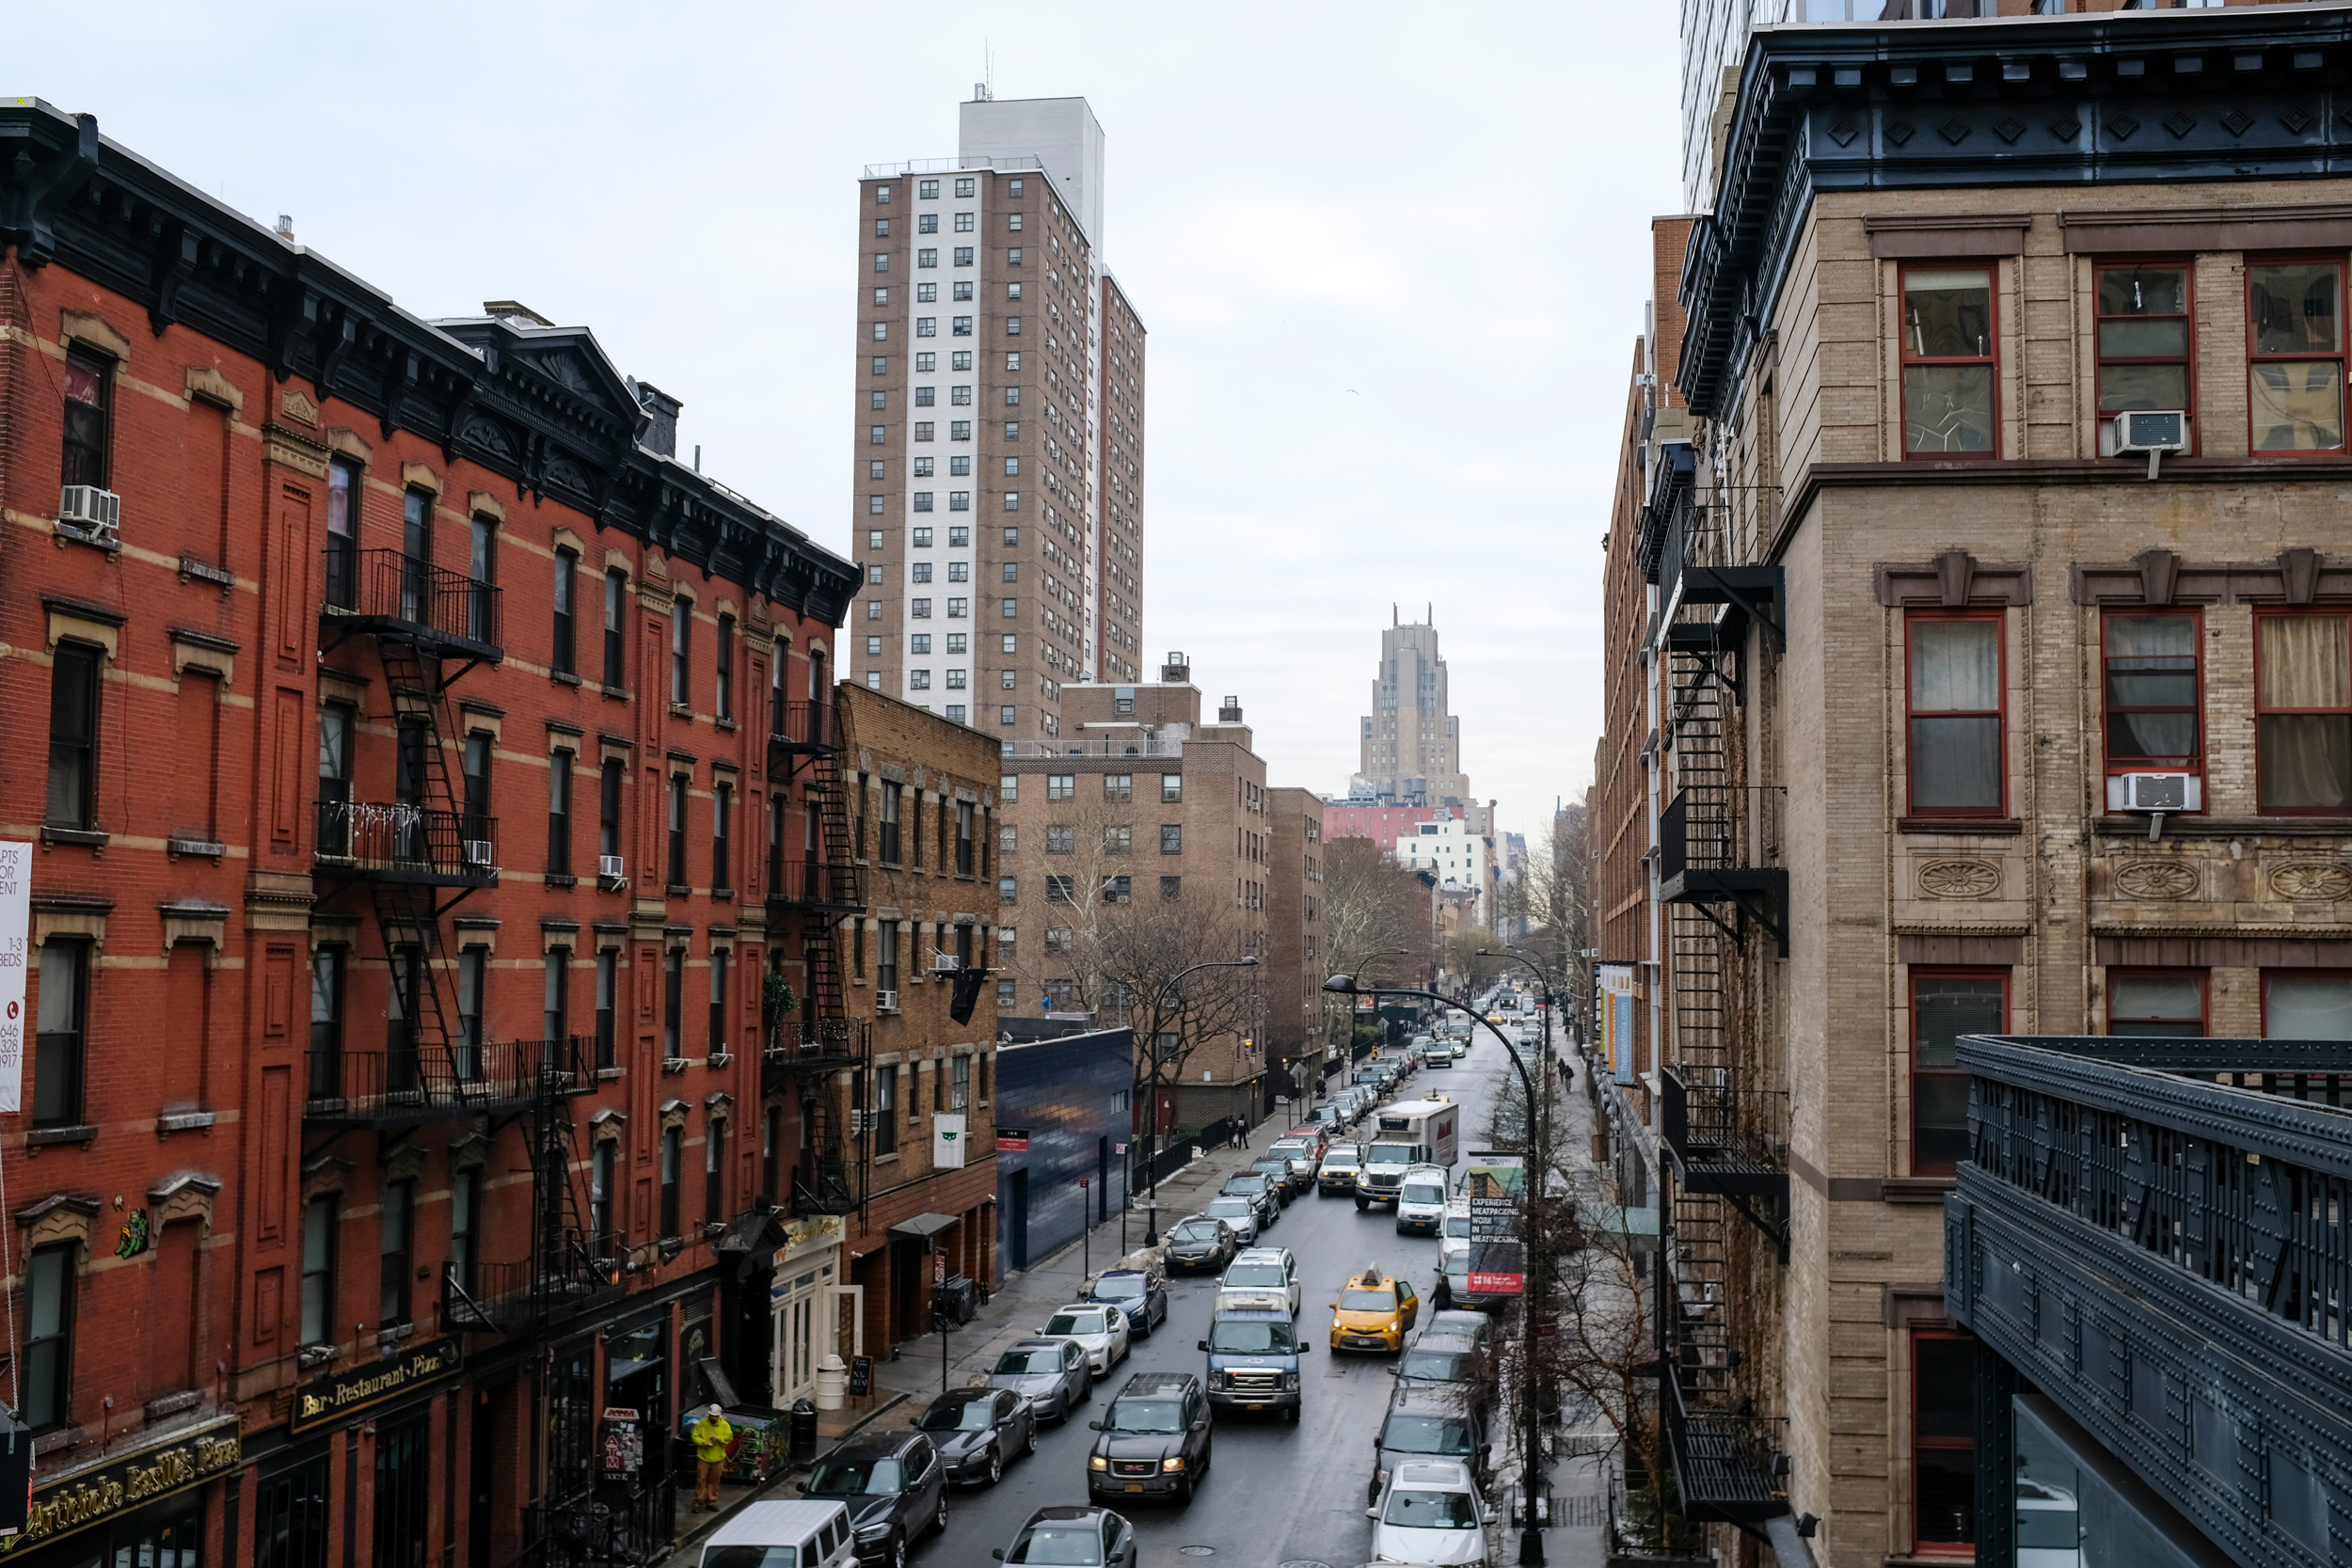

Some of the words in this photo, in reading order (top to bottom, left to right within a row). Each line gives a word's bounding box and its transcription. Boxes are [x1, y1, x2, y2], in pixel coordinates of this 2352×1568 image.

[0, 849, 19, 864] PTS
[8, 937, 23, 951] 1-3
[0, 1024, 19, 1038] 646
[1619, 1002, 1629, 1071] thecaledonia.com
[0, 1038, 19, 1053] 328
[1471, 1197, 1513, 1207] EXPERIENCE
[1471, 1216, 1493, 1225] WORK
[300, 1393, 326, 1418] Bar
[335, 1364, 405, 1406] Restaurant
[607, 1409, 635, 1418] ATM
[605, 1435, 619, 1468] ATM
